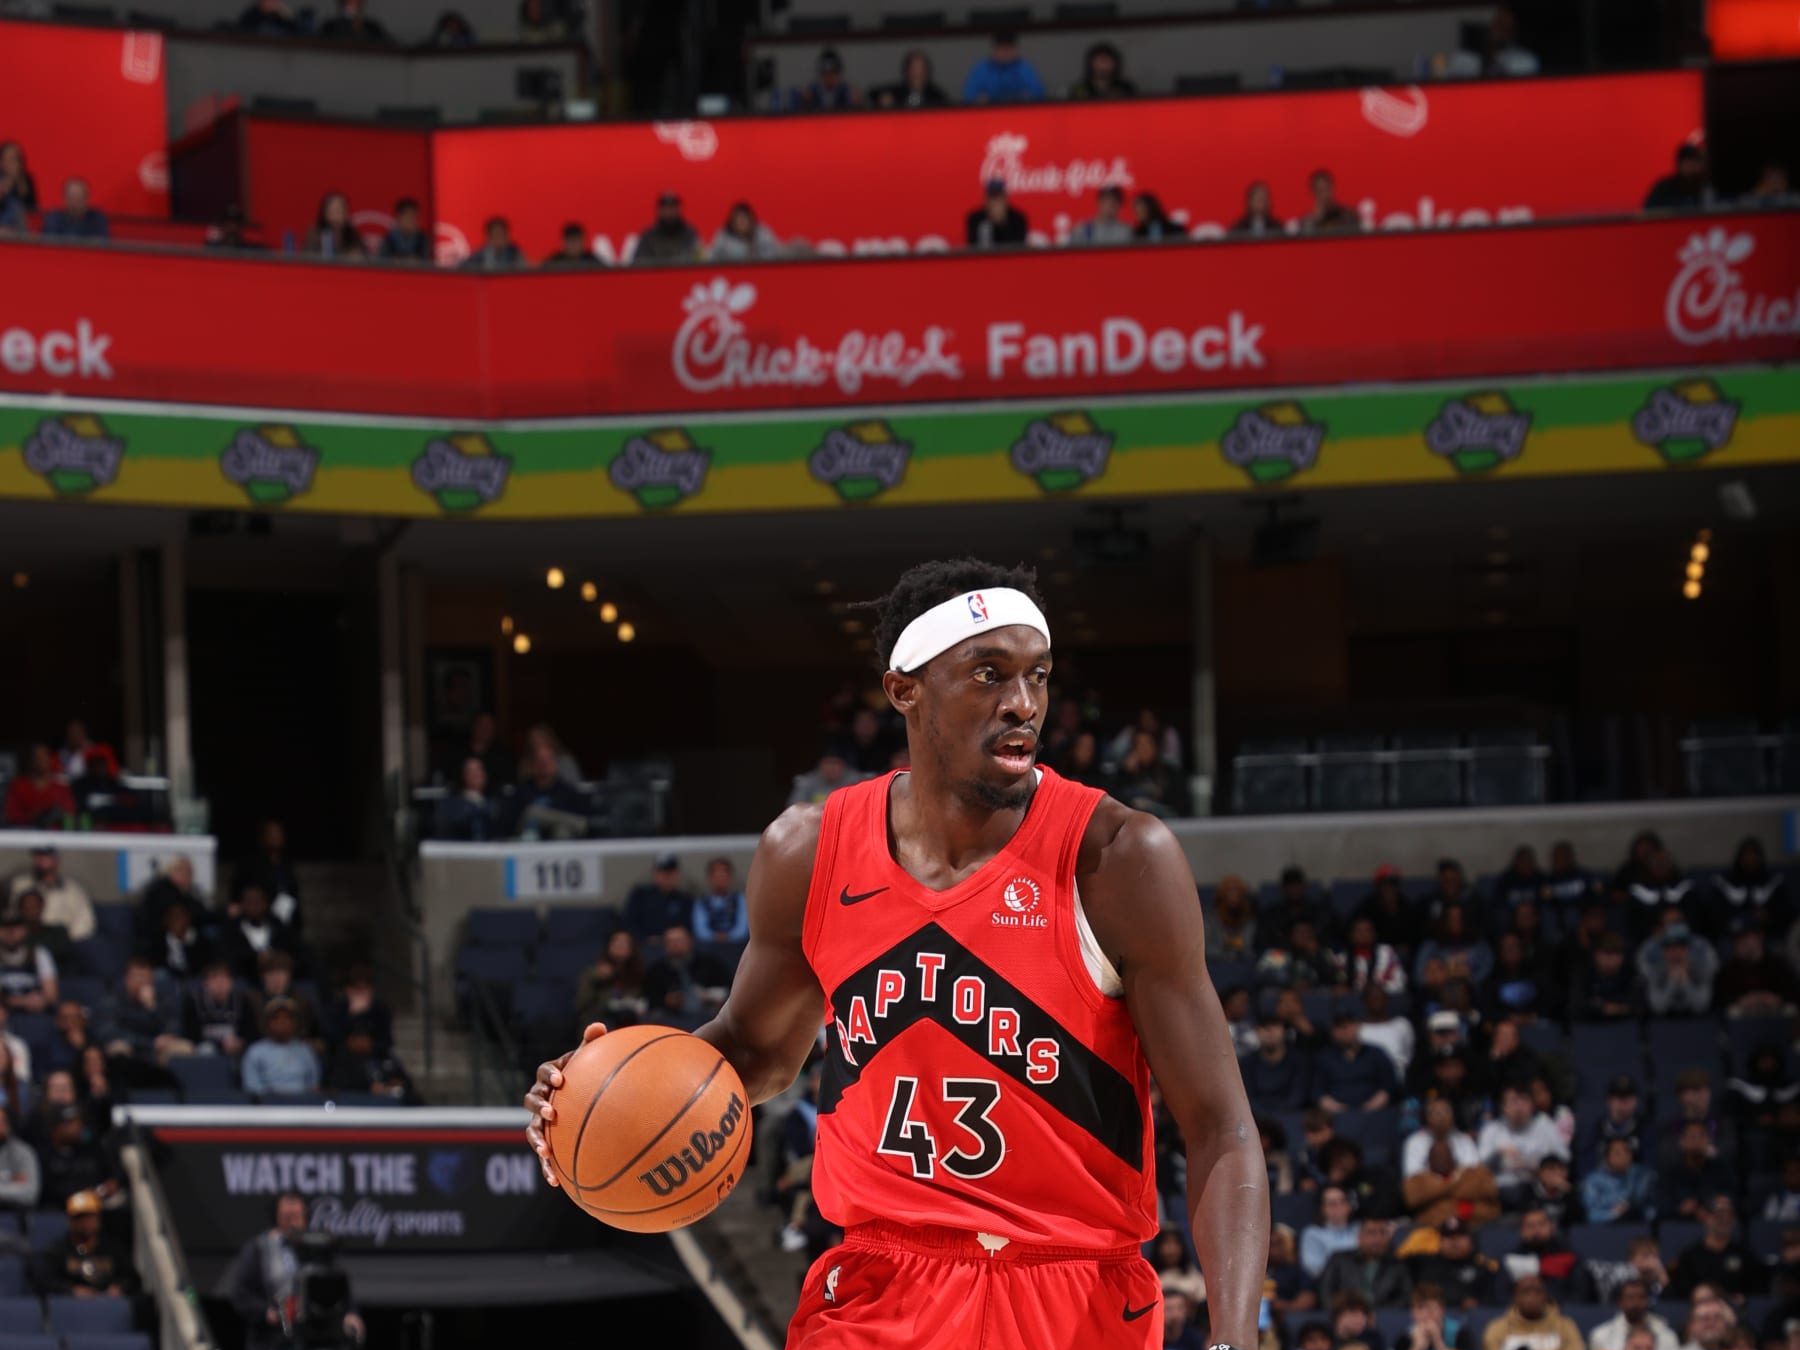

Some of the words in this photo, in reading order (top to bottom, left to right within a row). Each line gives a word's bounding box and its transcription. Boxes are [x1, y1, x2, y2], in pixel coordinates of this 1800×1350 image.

[987, 311, 1265, 379] FanDeck
[535, 861, 583, 891] 110
[992, 912, 1018, 925] Sun
[1022, 914, 1048, 927] Life
[837, 953, 1060, 1085] RAPTORS
[638, 1092, 744, 1196] Wilson
[877, 1076, 1006, 1179] 43
[223, 1154, 344, 1193] WATCH
[350, 1154, 416, 1192] THE
[486, 1154, 536, 1193] ON
[393, 1210, 464, 1236] SPORTS
